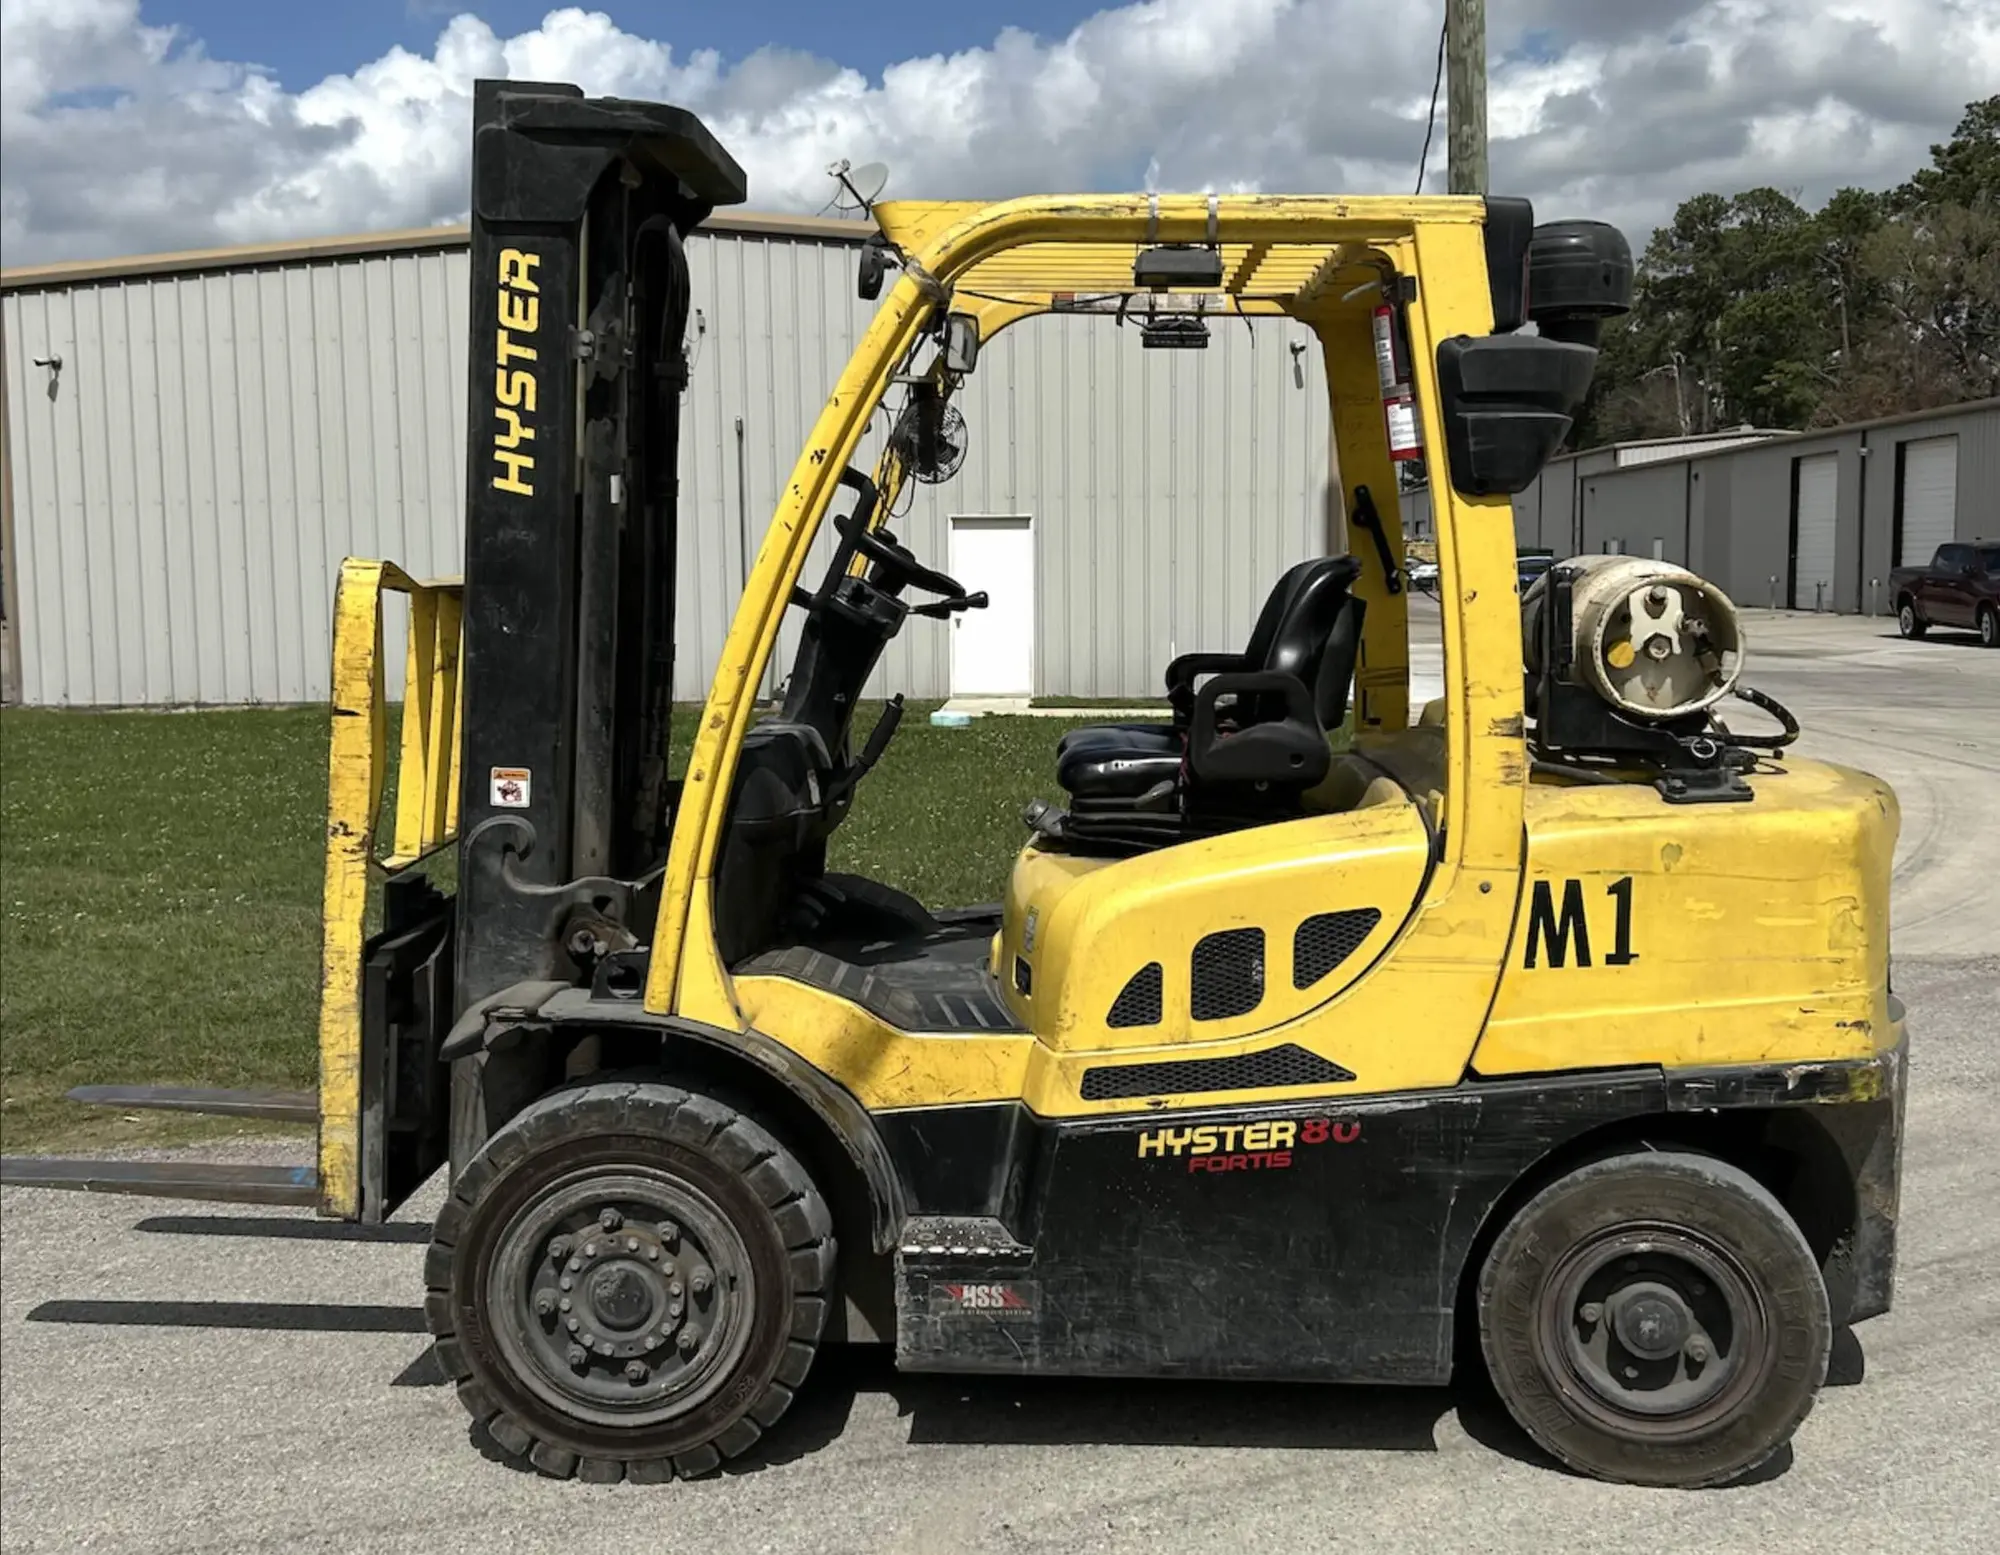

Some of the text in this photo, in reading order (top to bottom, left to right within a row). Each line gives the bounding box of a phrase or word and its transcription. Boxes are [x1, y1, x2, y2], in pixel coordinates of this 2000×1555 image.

[493, 248, 540, 497] HYSTER
[1523, 876, 1640, 969] M1
[1137, 1118, 1361, 1158] HYSTER 80
[1188, 1151, 1292, 1173] FORTIS
[962, 1284, 1005, 1308] HSS
